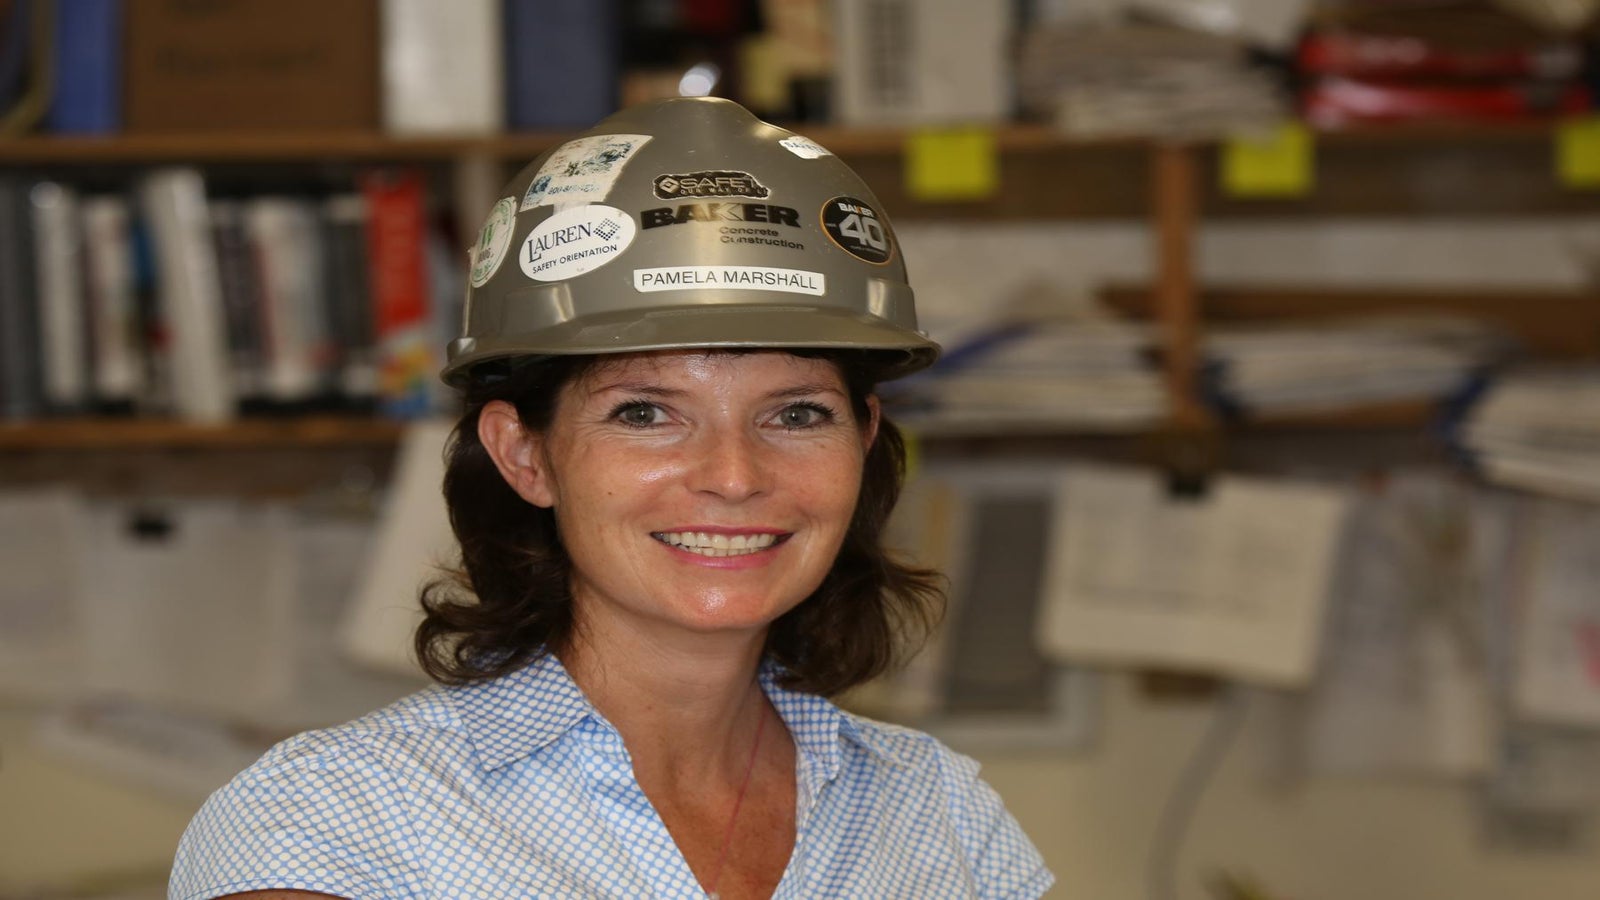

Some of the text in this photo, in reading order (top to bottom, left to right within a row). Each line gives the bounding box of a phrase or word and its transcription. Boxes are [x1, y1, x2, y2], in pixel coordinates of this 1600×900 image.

[680, 177, 756, 189] SAFET
[640, 203, 801, 230] BAKER
[837, 202, 874, 218] BAKER
[719, 226, 780, 237] Concrete
[838, 213, 887, 252] 40
[528, 222, 592, 263] LAUREN
[720, 235, 805, 250] Construction
[532, 244, 617, 274] SAFETY ORIENTATION
[642, 271, 817, 290] PAMELA MARSHALL
